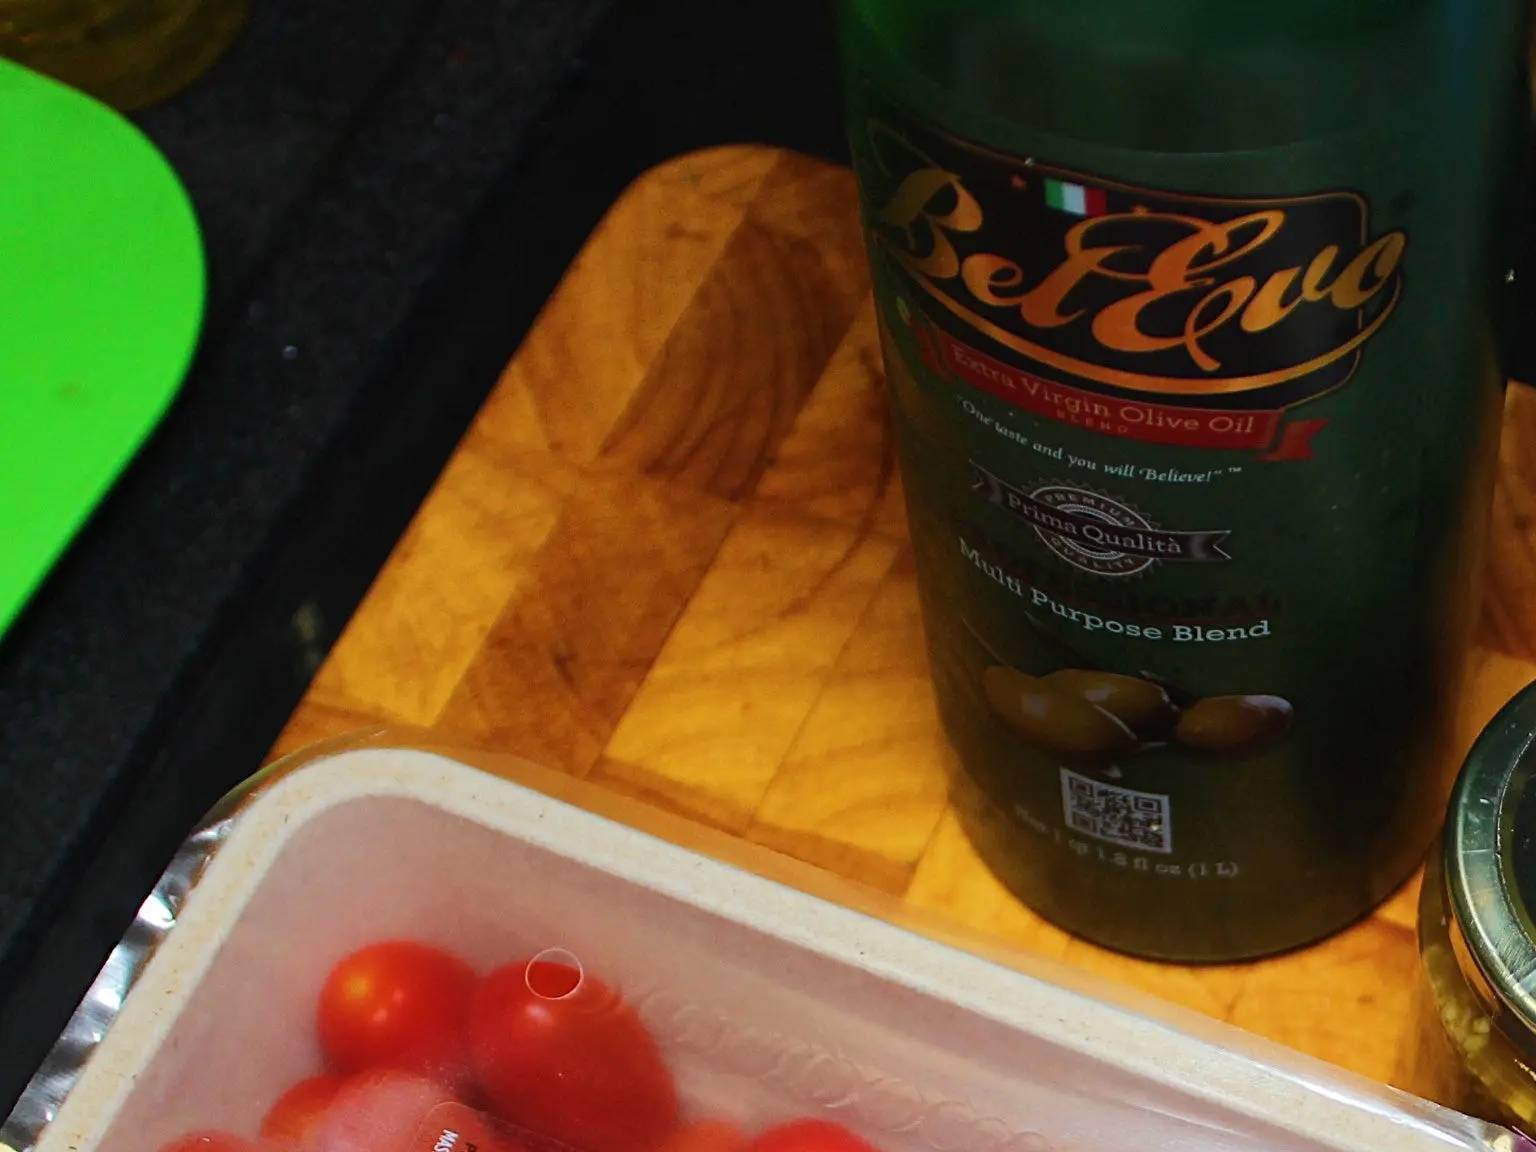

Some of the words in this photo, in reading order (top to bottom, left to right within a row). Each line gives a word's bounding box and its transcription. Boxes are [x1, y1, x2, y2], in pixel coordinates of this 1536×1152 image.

[952, 343, 1014, 390] Extra
[1021, 376, 1110, 416] Virgin
[1119, 405, 1200, 433] Olive
[1208, 416, 1254, 435] Oil
[1033, 438, 1063, 460] and
[1068, 452, 1096, 475] you
[1104, 459, 1136, 479] will
[1007, 491, 1077, 534] Prima
[958, 537, 1023, 597] Multi
[1031, 587, 1162, 641] Purpose
[1172, 620, 1271, 642] Blend
